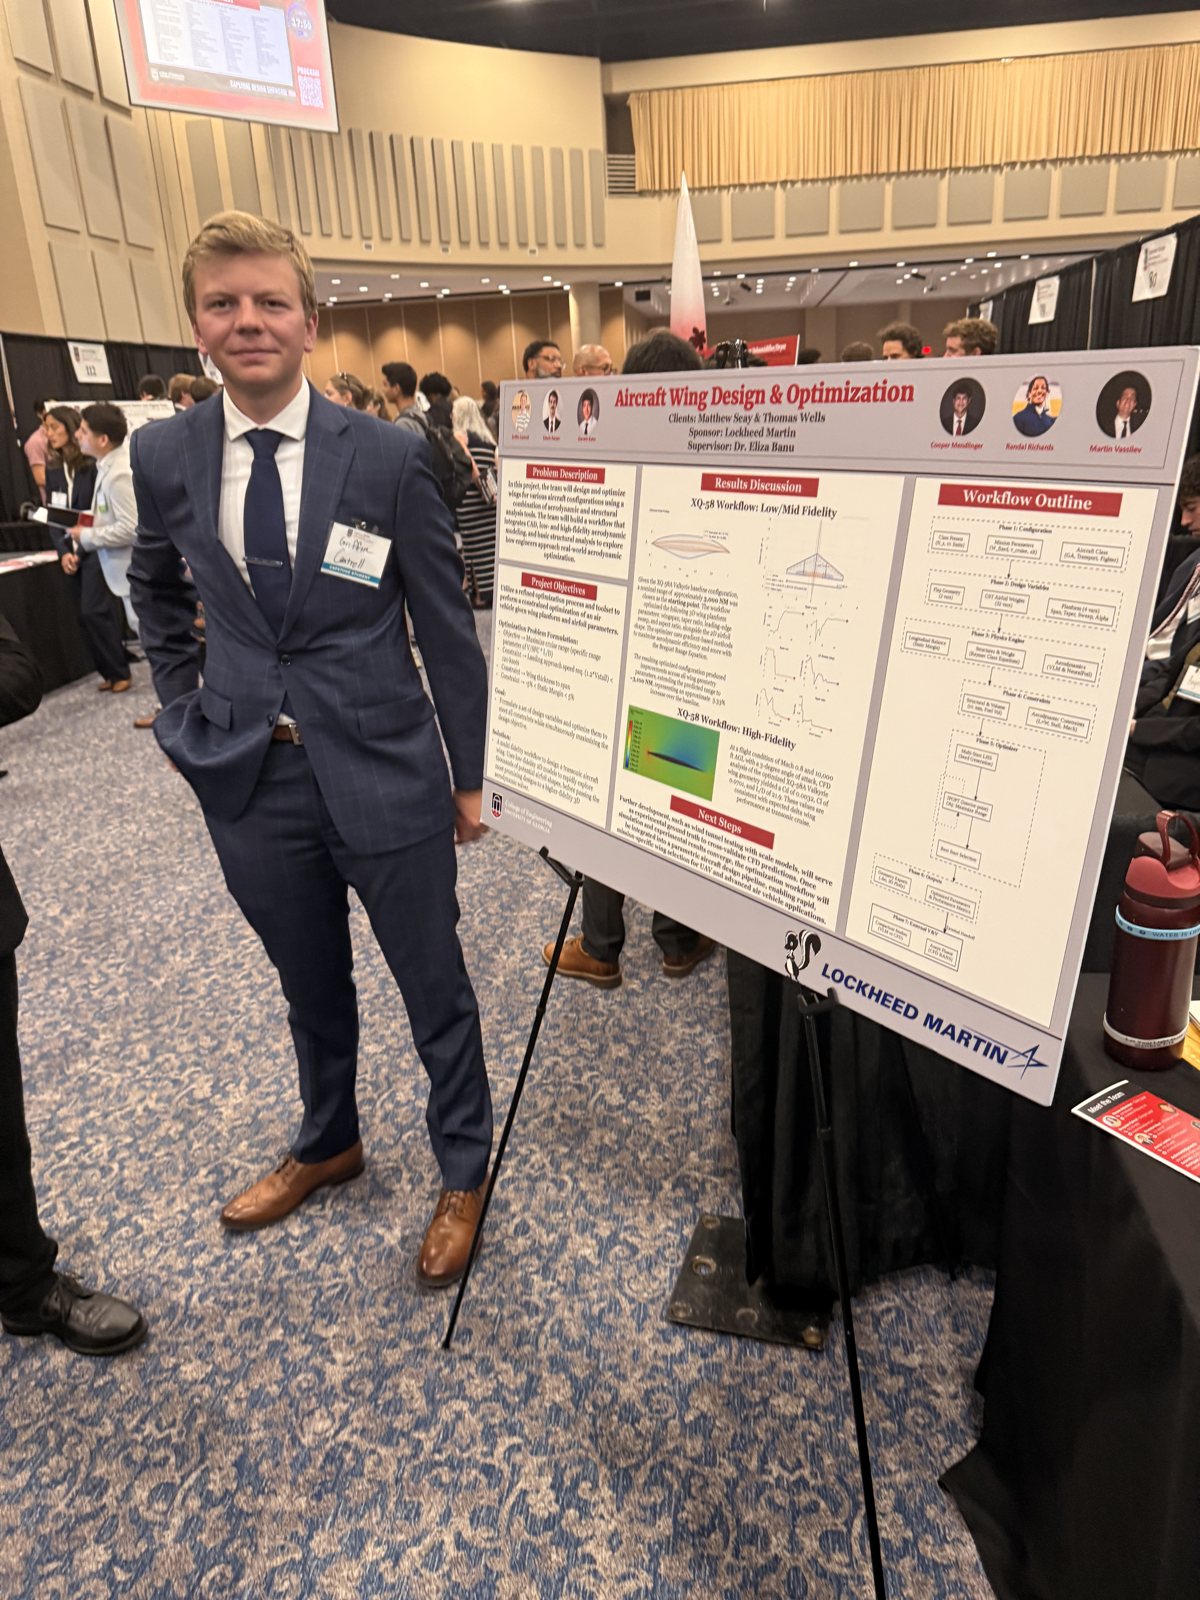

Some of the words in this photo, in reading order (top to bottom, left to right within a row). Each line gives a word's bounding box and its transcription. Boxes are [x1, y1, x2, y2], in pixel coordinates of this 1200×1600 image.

[614, 387, 667, 407] Aircraft
[668, 386, 708, 410] Wing
[710, 384, 766, 410] Design
[768, 383, 784, 404] &
[785, 379, 915, 409] Optimization
[668, 413, 696, 422] Clients:
[697, 413, 732, 422] Matthew
[733, 413, 752, 424] Seay
[753, 412, 761, 422] &
[762, 412, 798, 422] Thomas
[799, 412, 826, 422] Wells
[688, 427, 723, 438] Sponsor:
[724, 428, 764, 437] Lockheed
[765, 428, 796, 438] Martin
[687, 441, 732, 452] Supervisor:
[733, 442, 746, 451] Dr.
[748, 442, 770, 452] Eliza
[771, 442, 794, 452] Banu
[1027, 443, 1054, 451] Richards
[1088, 444, 1113, 452] Martin
[1113, 445, 1142, 453] Vassilev
[532, 467, 558, 478] Problem
[559, 468, 598, 482] Description
[714, 476, 748, 489] Results
[749, 478, 802, 493] Discussion
[690, 497, 715, 510] XQ-58
[716, 499, 759, 512] Workflow:
[760, 502, 800, 515] Low/Mid
[801, 505, 837, 520] Fidelity
[961, 489, 1032, 506] Workflow
[1034, 493, 1093, 510] Outline
[531, 576, 552, 589] Project
[553, 580, 585, 595] Objectives
[676, 707, 700, 722] XQ-58
[700, 714, 740, 734] Workflow:
[741, 725, 796, 752] High-Fidelity
[698, 808, 717, 824] Next
[718, 816, 741, 834] Steps
[822, 963, 919, 1020] LOCKHEED
[922, 1013, 1009, 1066] MARTIN
[1087, 1100, 1103, 1114] Meet
[1102, 1096, 1112, 1104] the
[1110, 1091, 1126, 1102] Team
